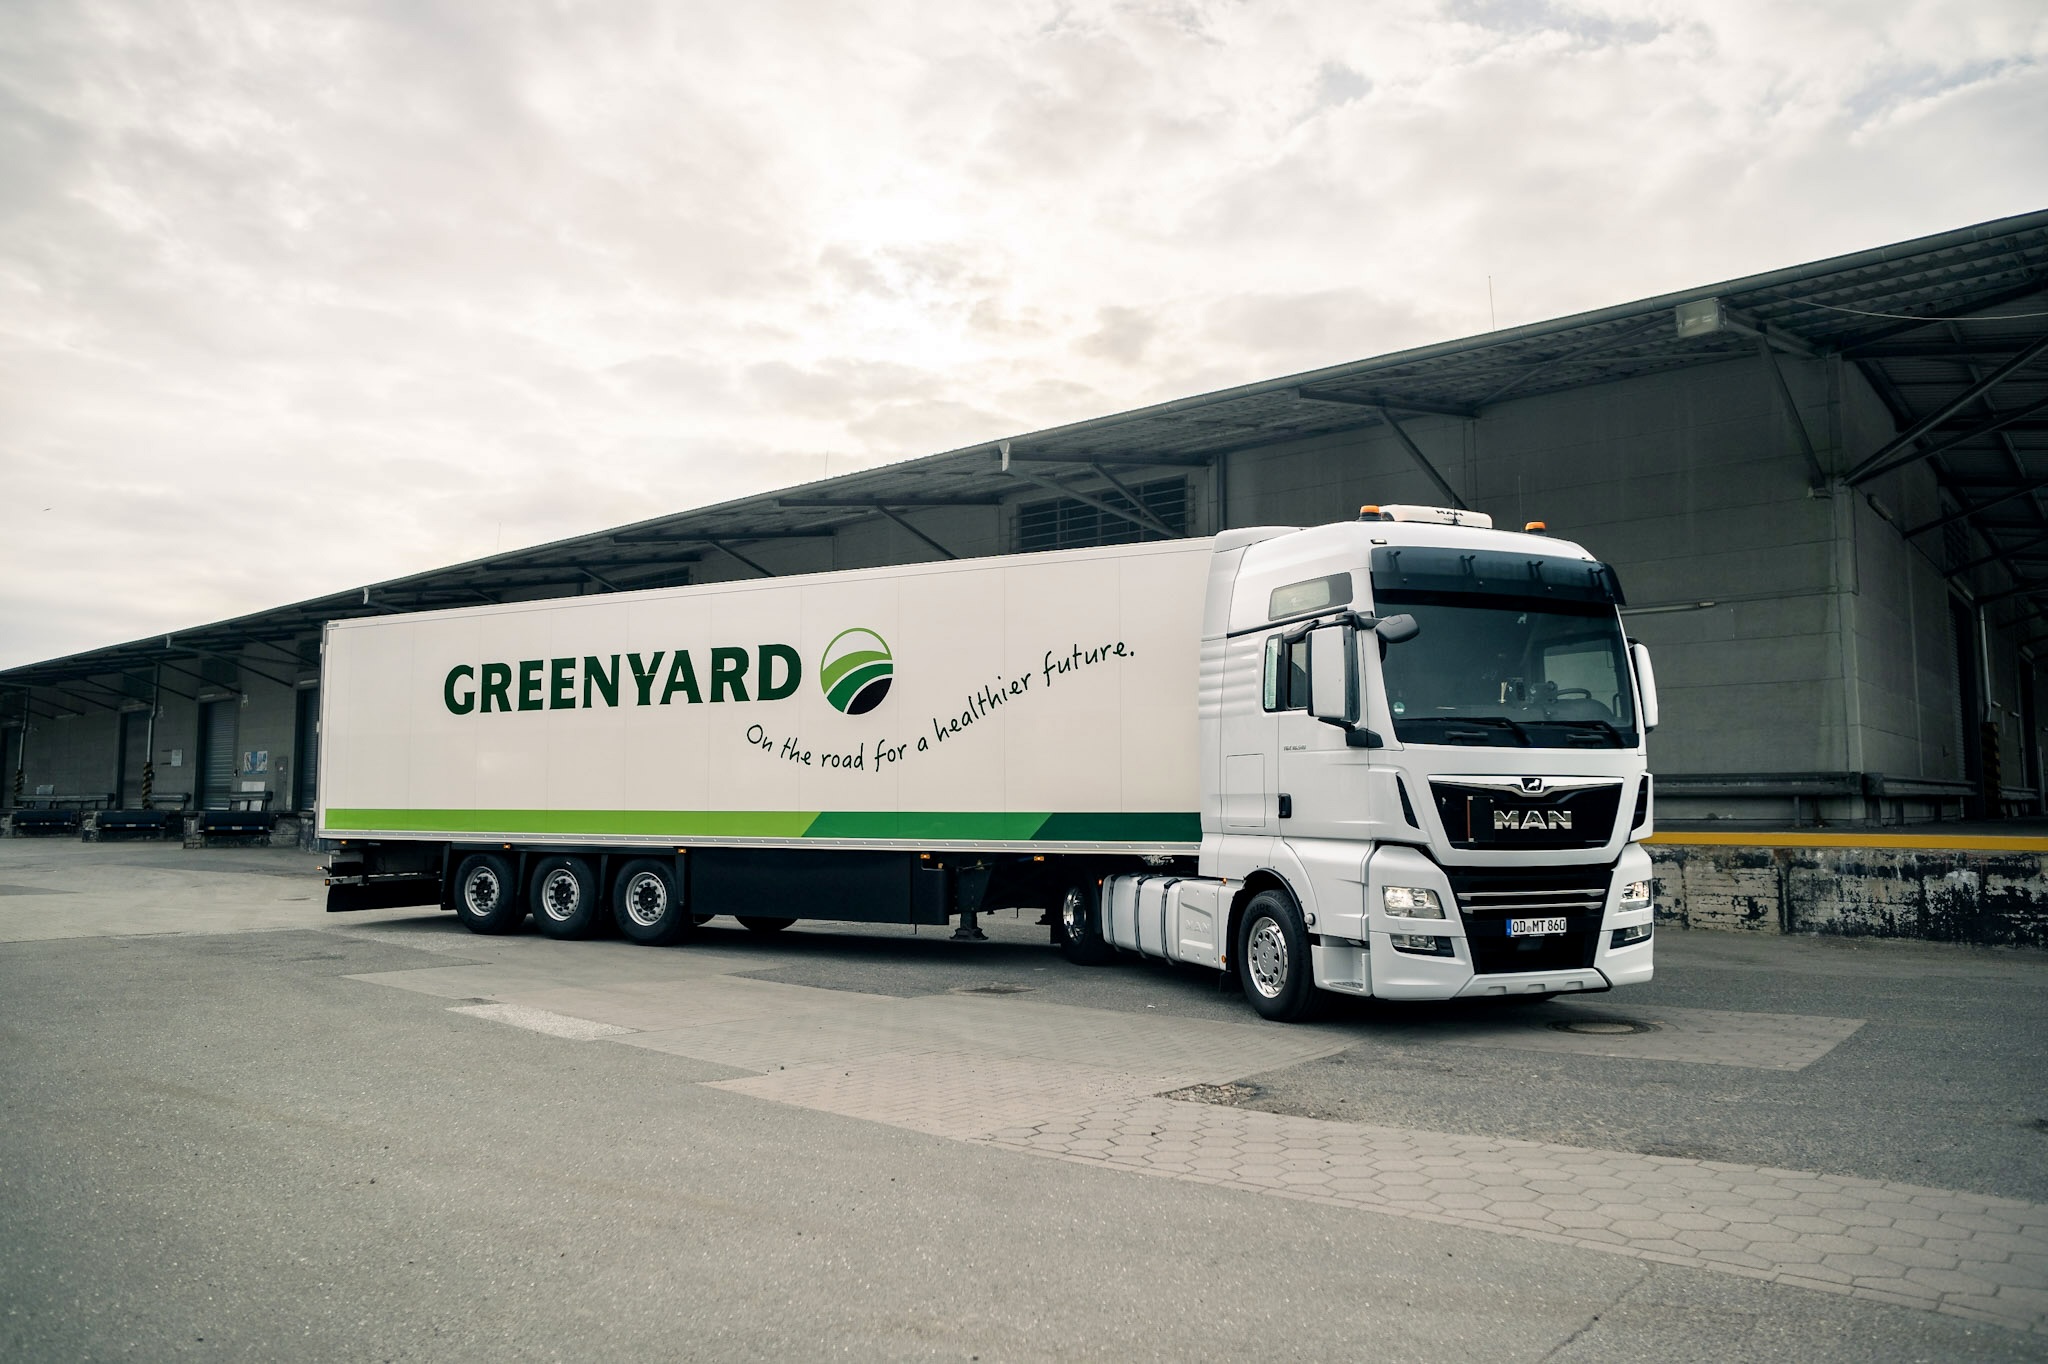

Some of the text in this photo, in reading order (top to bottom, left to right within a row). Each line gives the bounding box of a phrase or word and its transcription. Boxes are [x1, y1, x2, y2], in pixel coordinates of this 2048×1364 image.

[443, 643, 802, 716] GREENYARD
[746, 640, 1136, 773] On the road for a healthier future.
[1494, 810, 1572, 829] MAN
[1512, 919, 1566, 933] OD MT 860
